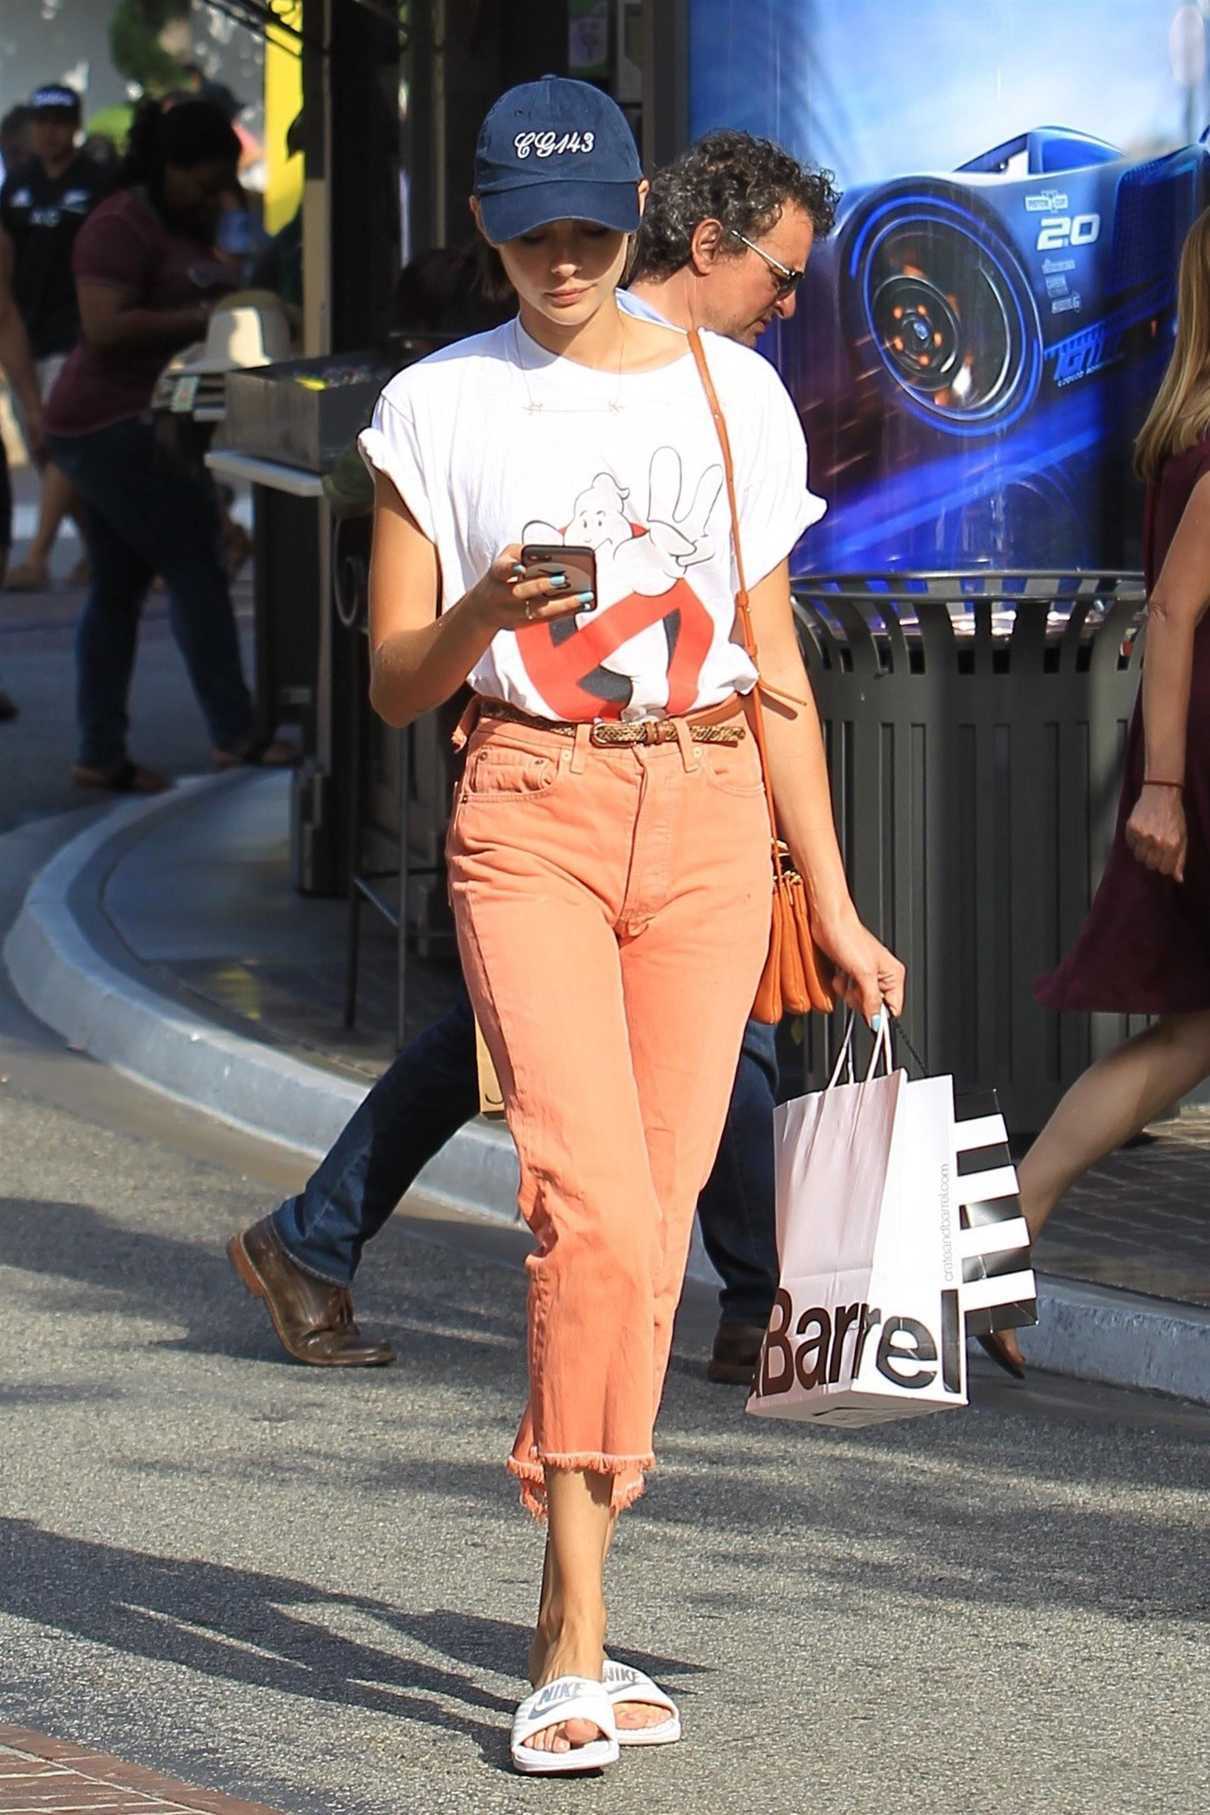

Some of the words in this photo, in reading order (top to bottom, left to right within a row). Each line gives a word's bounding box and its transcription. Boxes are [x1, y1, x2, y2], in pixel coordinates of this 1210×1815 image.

[939, 1162, 954, 1282] crateandbarrel.com
[760, 1287, 962, 1400] Barrel
[536, 1681, 584, 1706] NIKE
[602, 1665, 640, 1683] NIKE
